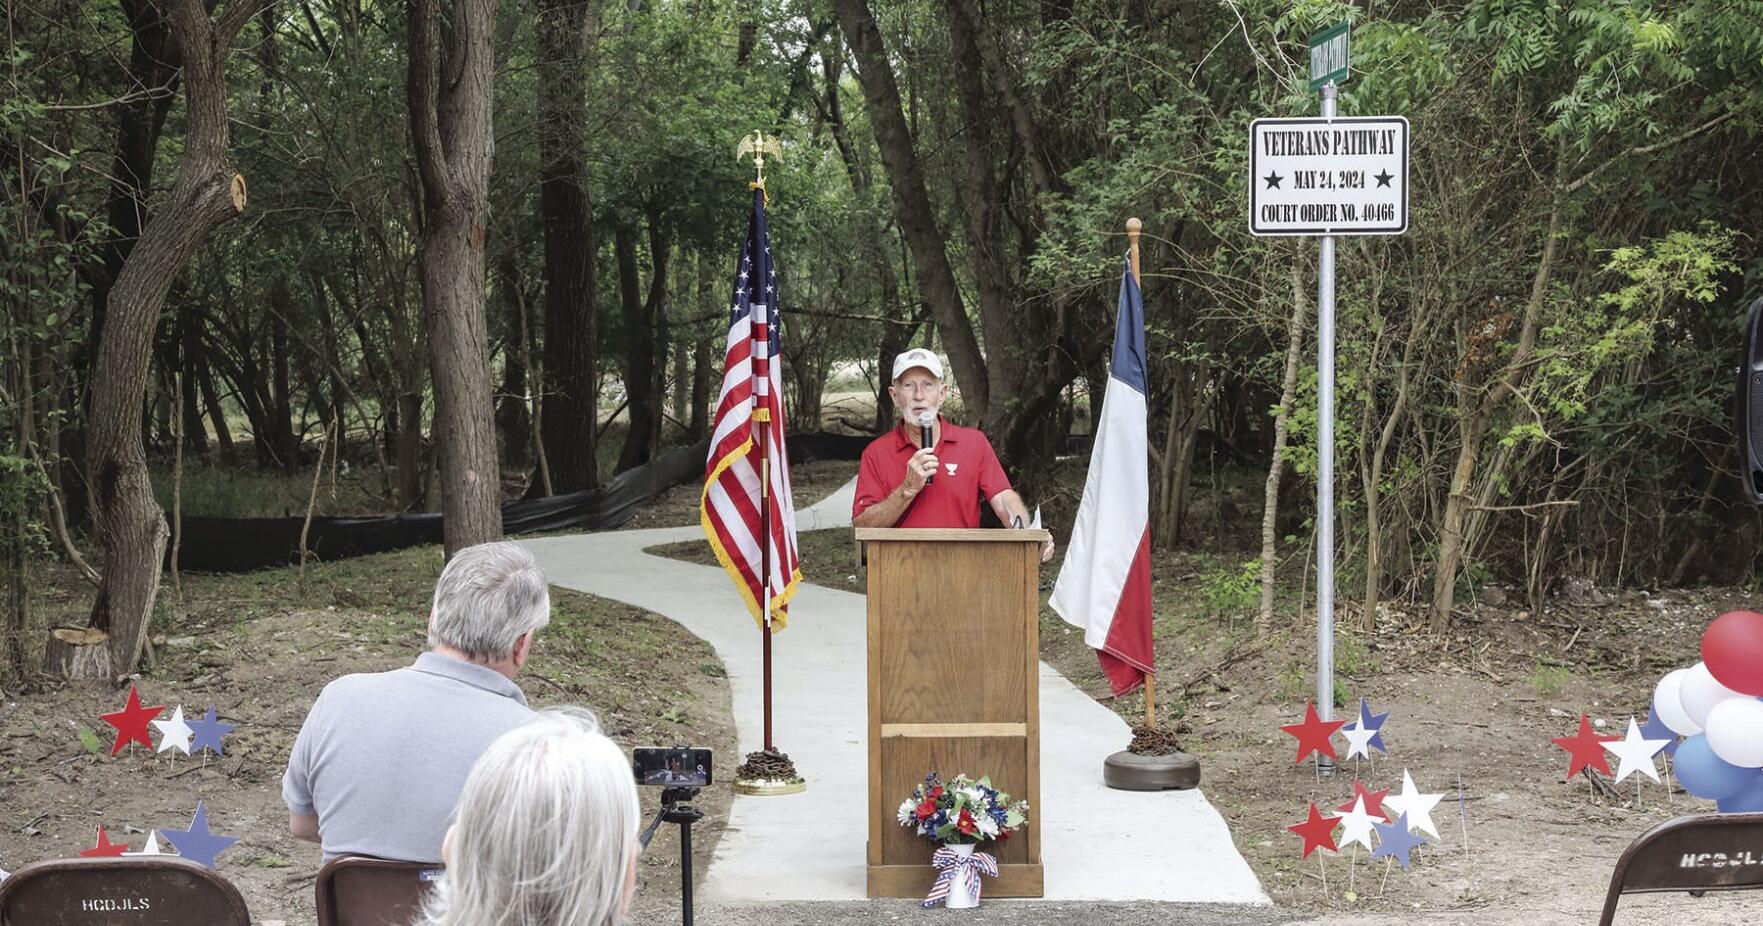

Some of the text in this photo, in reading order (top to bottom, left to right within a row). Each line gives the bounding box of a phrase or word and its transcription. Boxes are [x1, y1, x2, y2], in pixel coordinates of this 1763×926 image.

[1263, 129, 1396, 156] VETERANS PATHWAY
[1294, 170, 1365, 192] MAY 24, 2024
[1261, 203, 1395, 223] COURT ORDER NO. 40466
